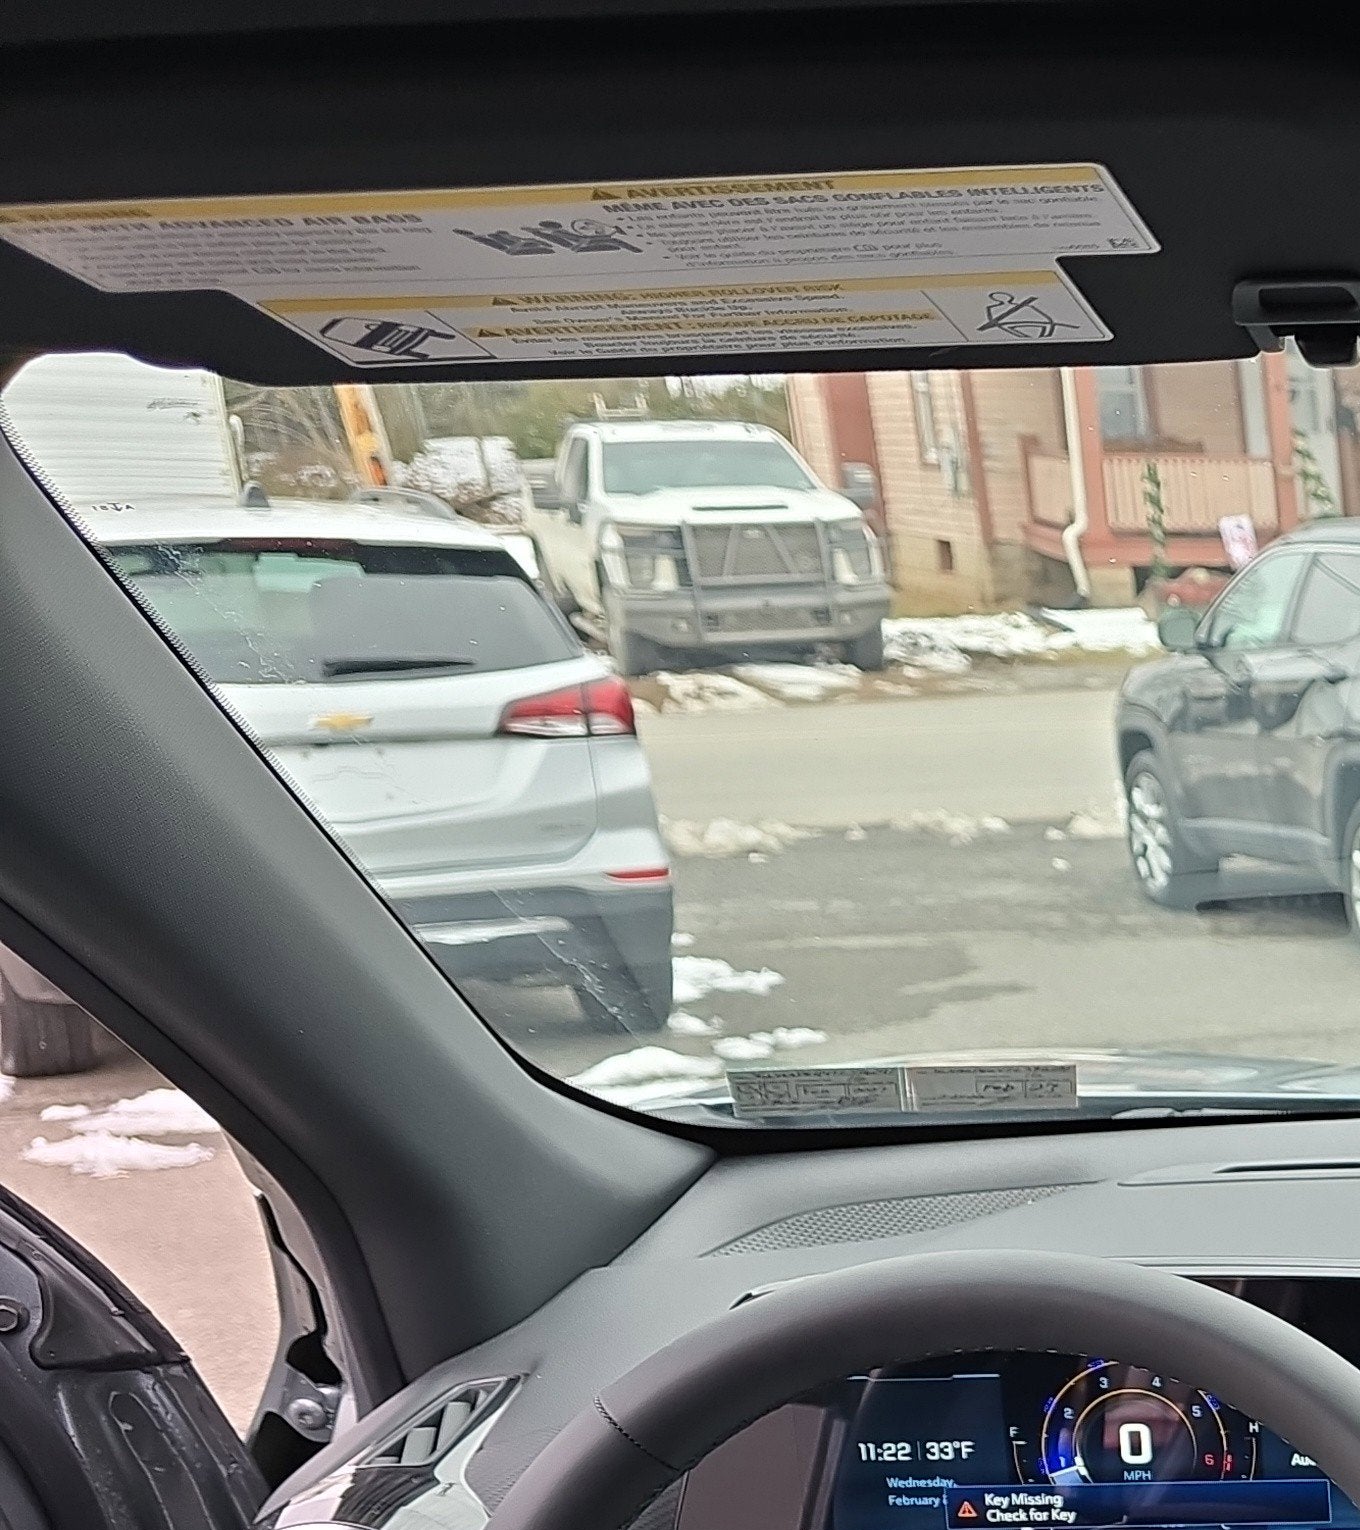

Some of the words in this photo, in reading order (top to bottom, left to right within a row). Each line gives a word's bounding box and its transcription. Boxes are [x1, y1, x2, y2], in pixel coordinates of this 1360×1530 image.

[627, 180, 834, 199] AVERTISSEMENT
[1099, 1377, 1109, 1389] 3
[1151, 1375, 1162, 1387] 4
[1063, 1407, 1075, 1419] 2
[1191, 1405, 1202, 1418] 5
[1119, 1422, 1153, 1465] 0
[858, 1442, 913, 1461] 11:22
[1204, 1454, 1215, 1466] 6
[1123, 1469, 1152, 1481] MPH
[888, 1494, 941, 1507] February
[984, 1493, 1010, 1507] Key
[1011, 1492, 1065, 1508] Missing
[986, 1509, 1030, 1523] Check
[1029, 1509, 1049, 1522] for
[1051, 1509, 1078, 1524] Key
